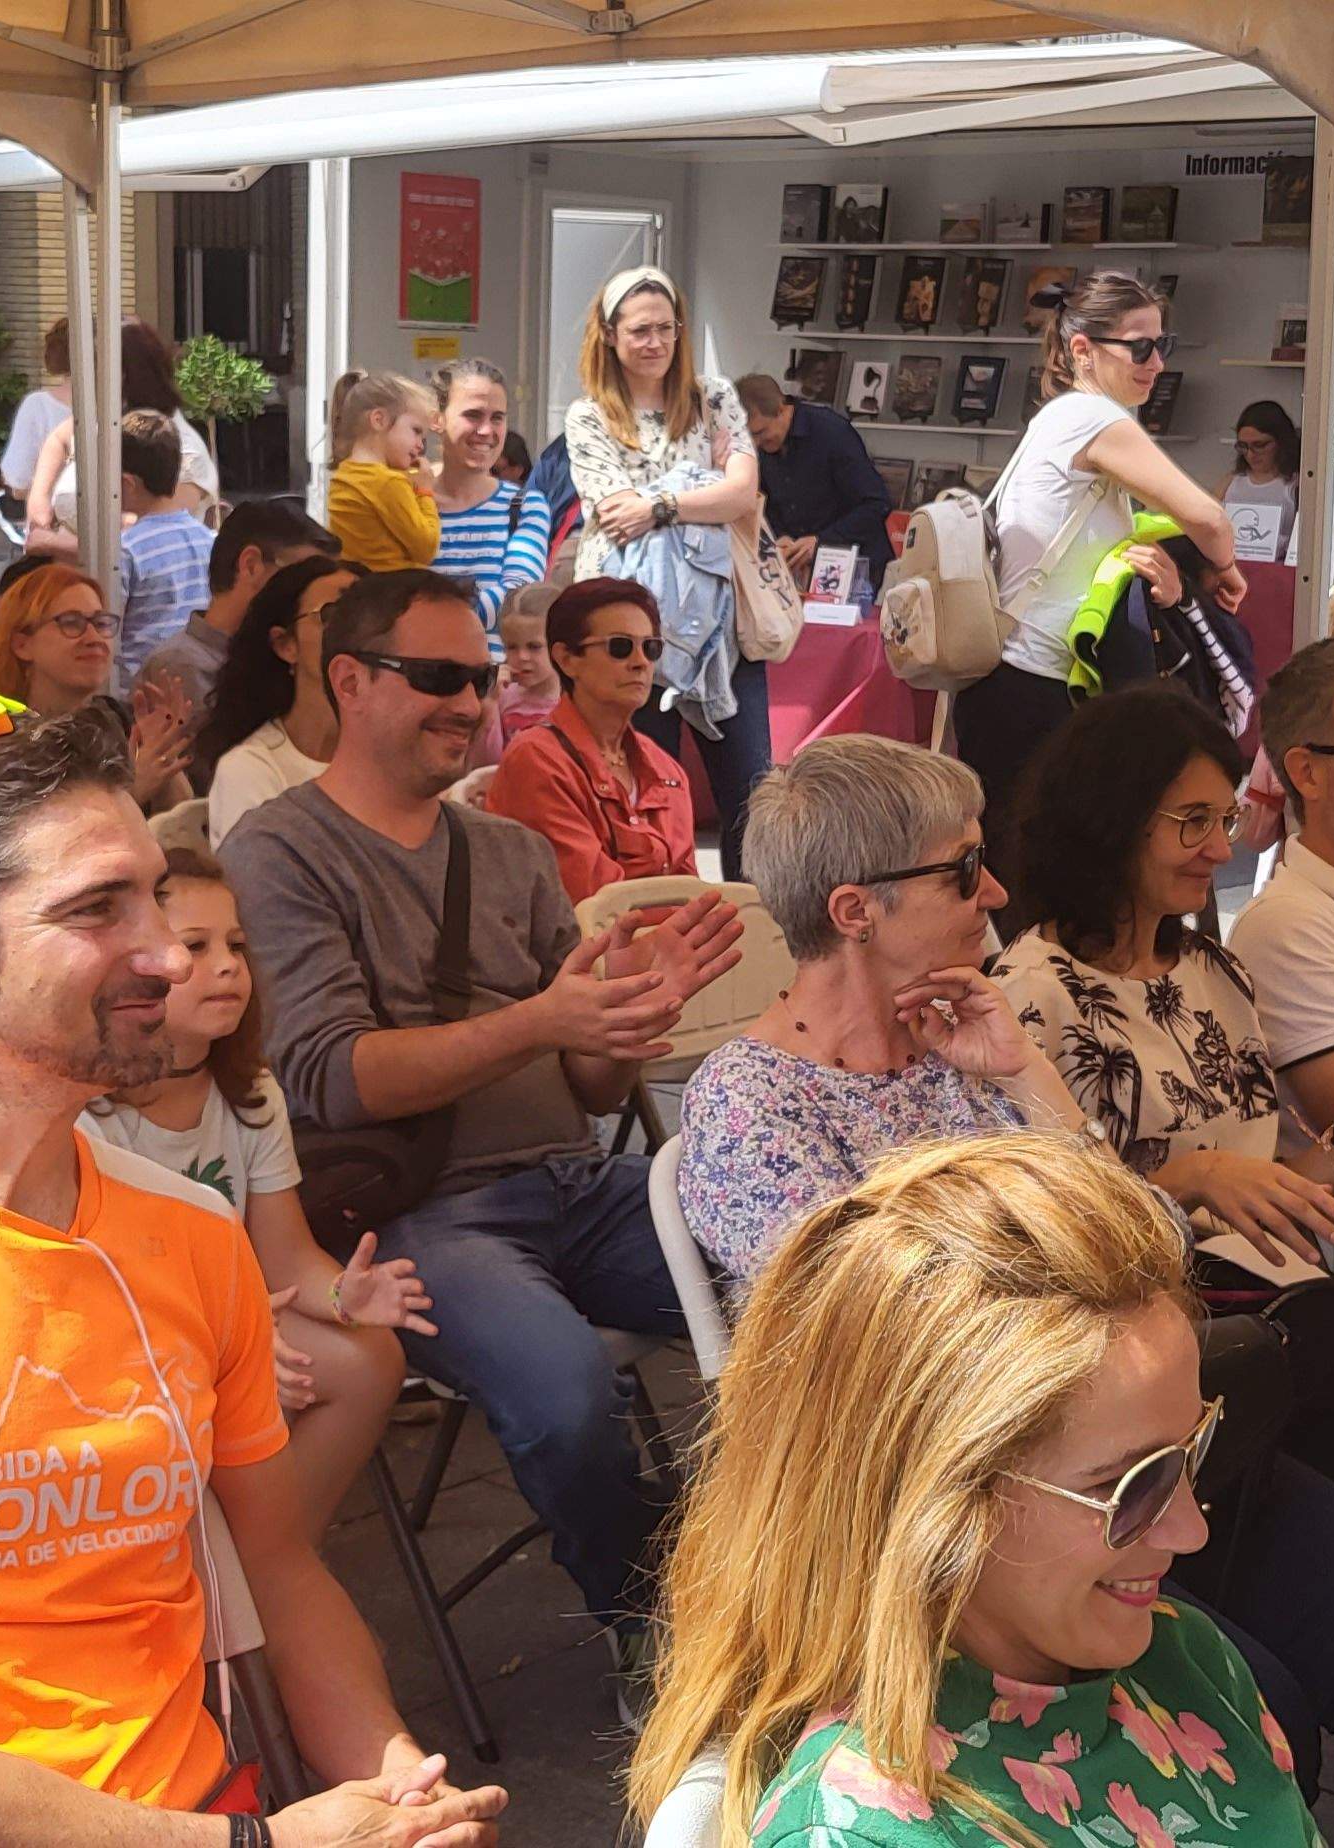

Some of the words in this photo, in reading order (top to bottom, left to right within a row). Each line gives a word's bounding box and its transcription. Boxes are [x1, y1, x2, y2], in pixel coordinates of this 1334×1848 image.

[1185, 151, 1283, 176] Informac
[78, 1440, 102, 1470] A
[26, 1540, 58, 1566] DE
[59, 1520, 180, 1558] VELOCIDAD
